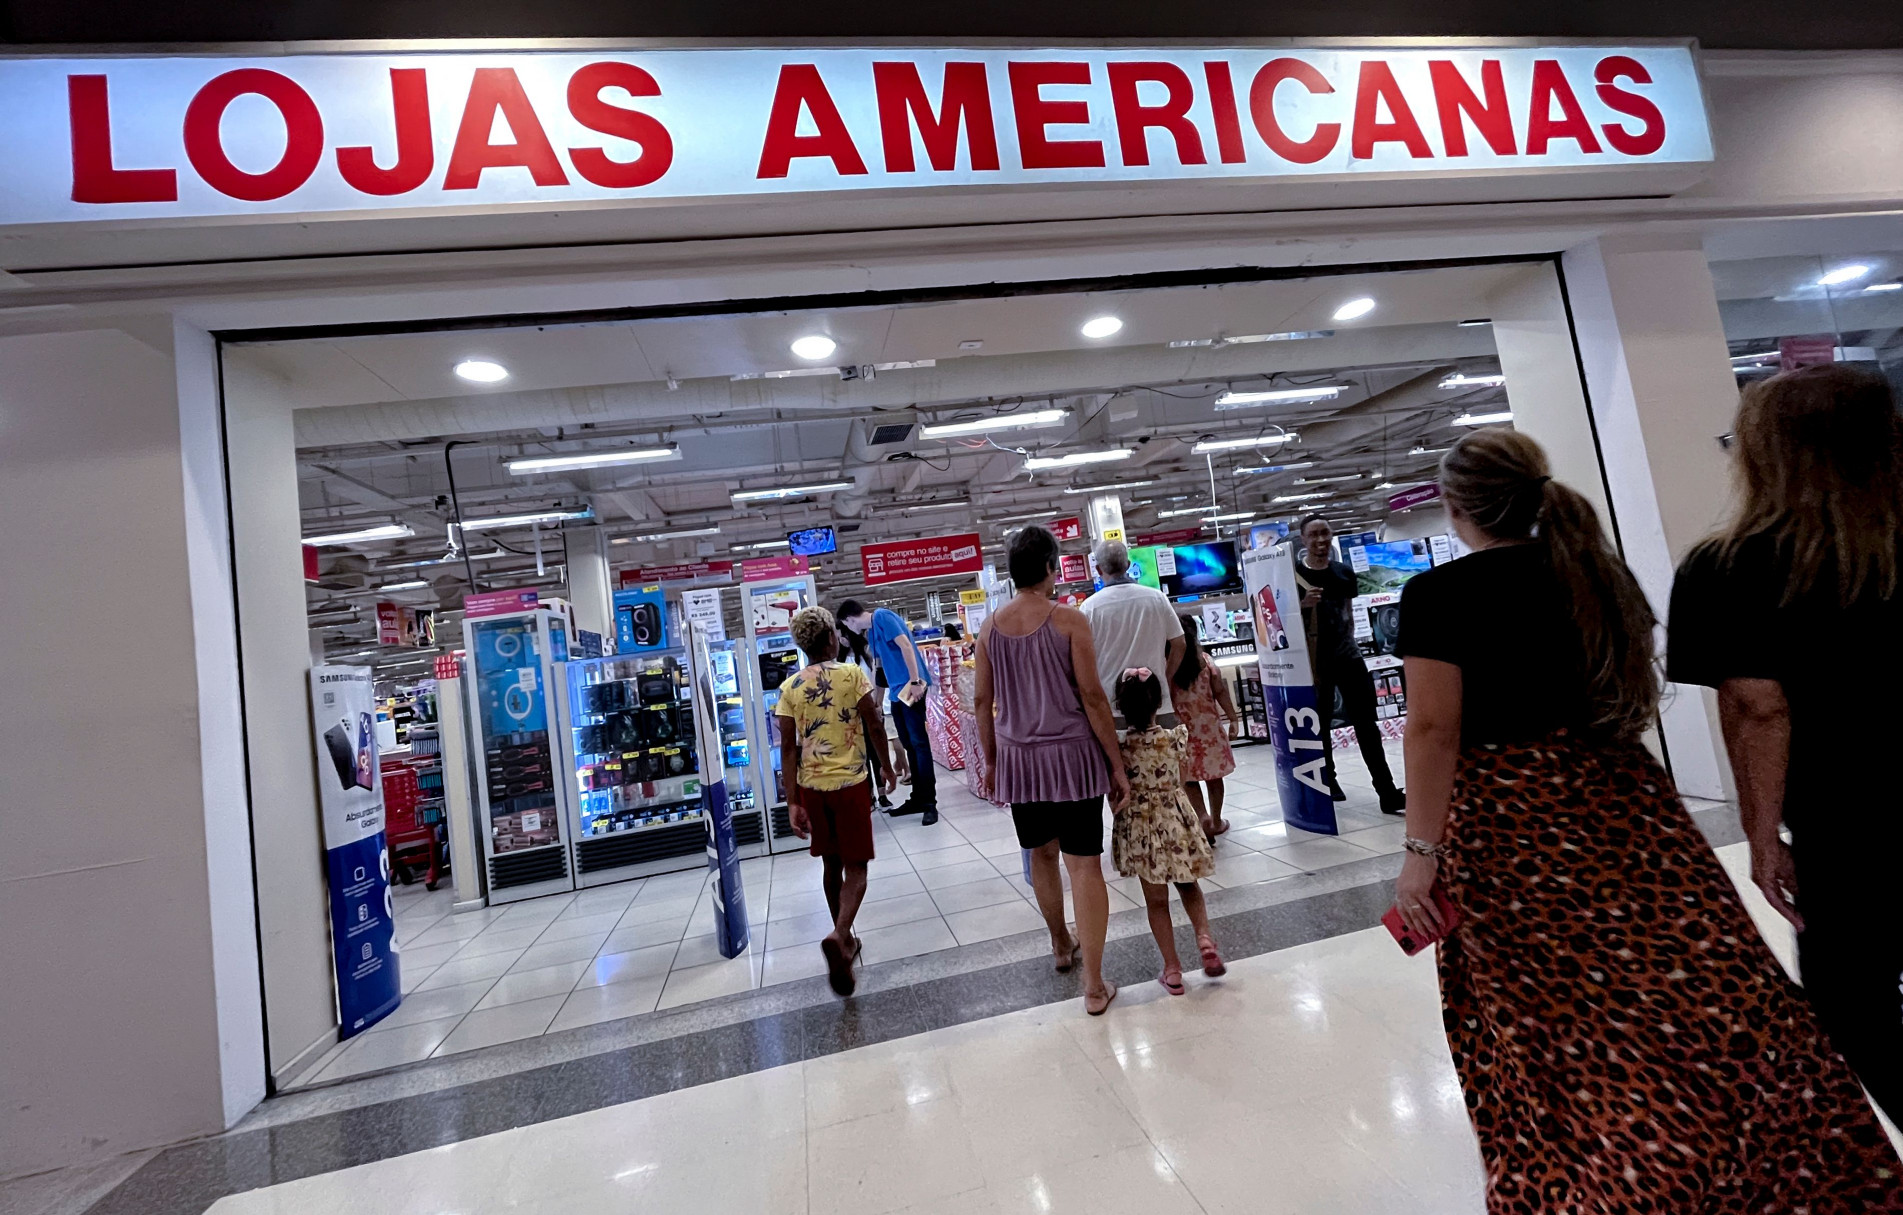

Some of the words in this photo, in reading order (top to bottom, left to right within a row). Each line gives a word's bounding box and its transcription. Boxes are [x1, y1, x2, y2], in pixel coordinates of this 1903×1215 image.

[70, 61, 674, 204] LOJAS
[756, 55, 1666, 179] AMERICANAS
[886, 549, 915, 559] compre
[927, 546, 942, 554] site
[887, 557, 907, 567] retire
[908, 556, 923, 565] seu
[923, 553, 952, 564] produto
[954, 547, 974, 559] aqui!
[1211, 643, 1254, 657] SAMSUNG
[1284, 706, 1331, 796] A13
